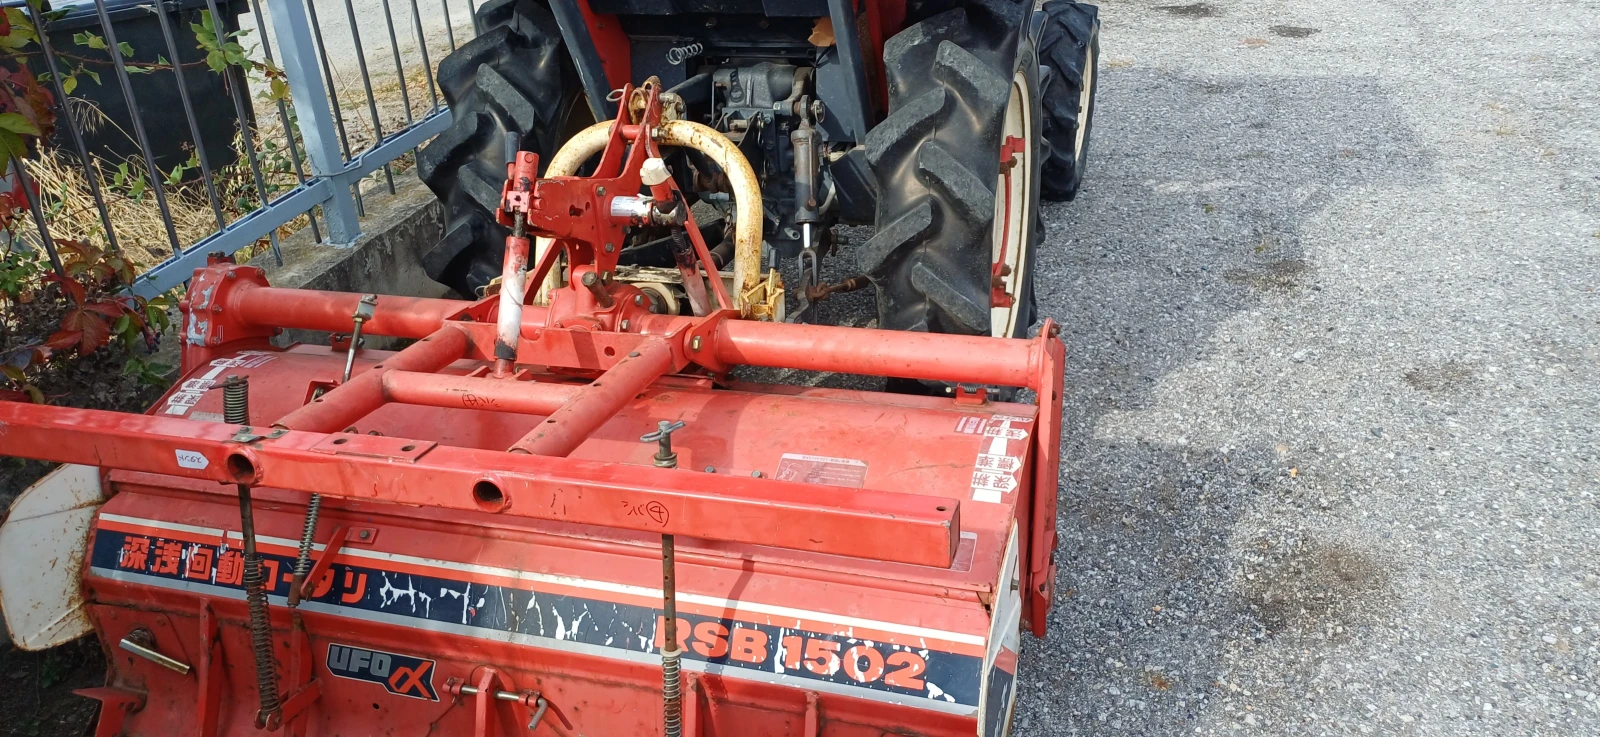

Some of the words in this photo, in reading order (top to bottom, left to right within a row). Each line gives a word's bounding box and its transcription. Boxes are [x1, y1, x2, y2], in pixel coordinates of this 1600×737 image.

[171, 392, 201, 405] 深耕
[977, 455, 1015, 470] 標準
[972, 472, 1012, 490] 深耕
[328, 645, 392, 678] UFO
[655, 615, 768, 664] RSB
[782, 635, 926, 691] 1502
